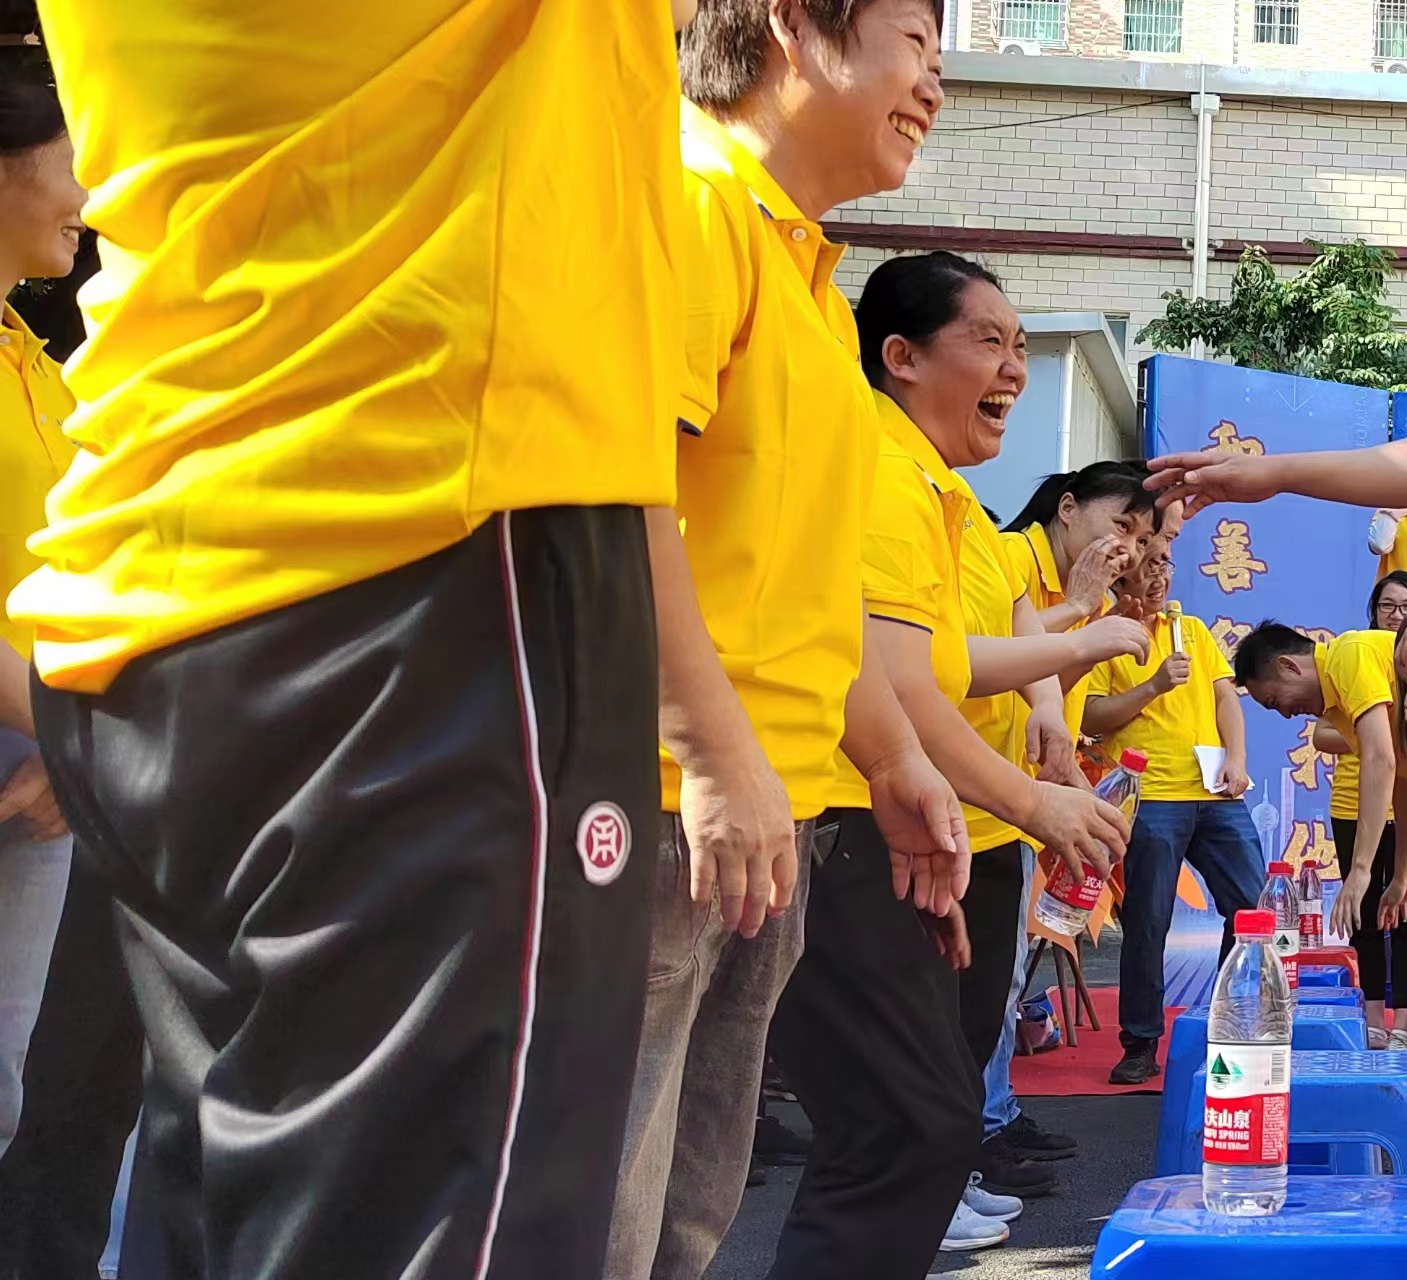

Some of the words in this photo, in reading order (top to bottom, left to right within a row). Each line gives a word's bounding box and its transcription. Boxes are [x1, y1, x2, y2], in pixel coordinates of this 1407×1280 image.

[1204, 1107, 1250, 1129] 夫山泉
[1218, 1129, 1250, 1141] SPRING
